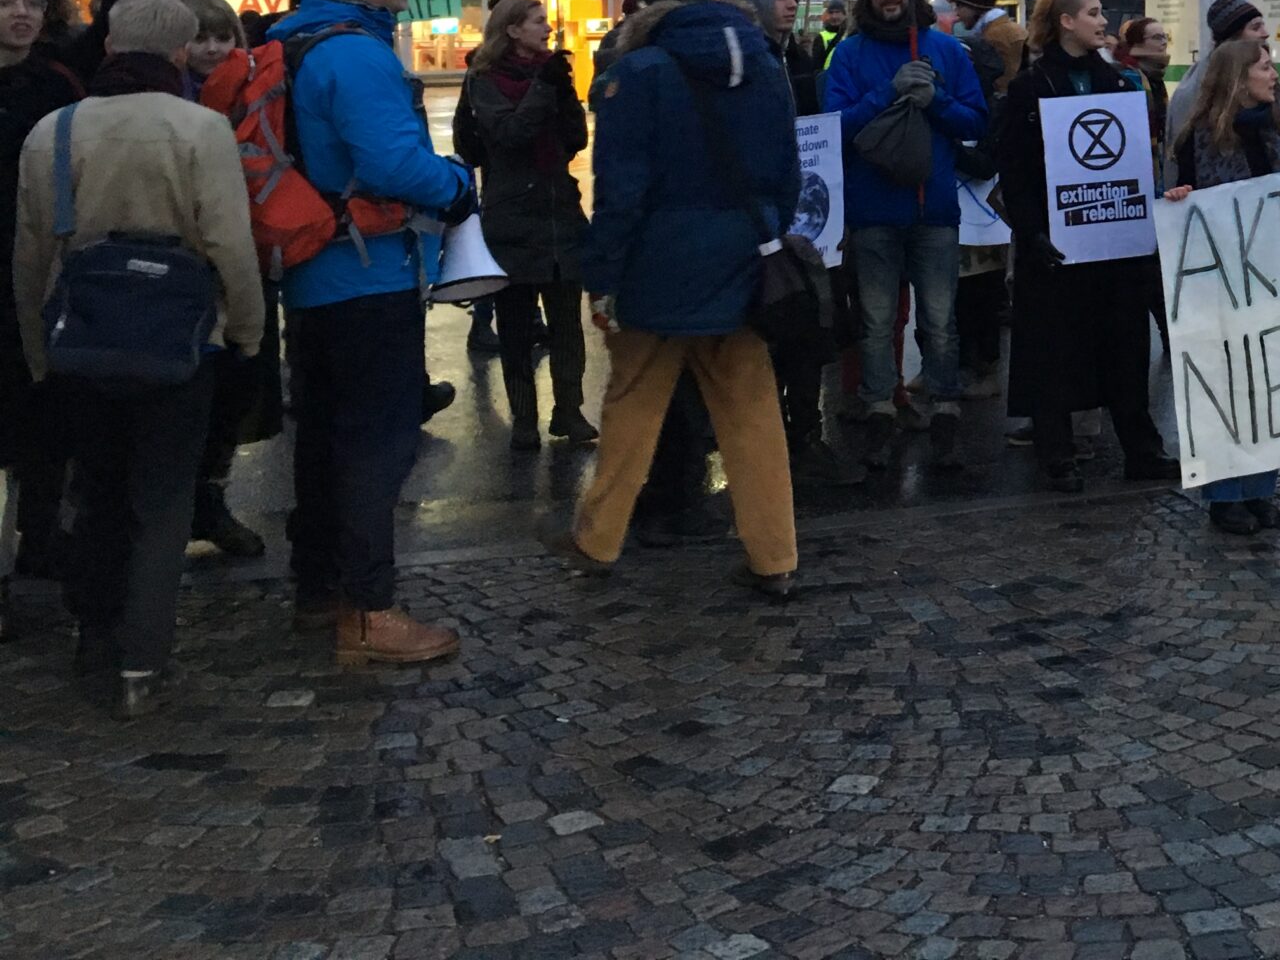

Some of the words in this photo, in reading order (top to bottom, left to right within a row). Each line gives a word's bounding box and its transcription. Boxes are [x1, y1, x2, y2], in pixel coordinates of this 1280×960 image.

[796, 125, 819, 136] mate
[1059, 182, 1129, 204] extinction
[1083, 198, 1145, 223] rebellion
